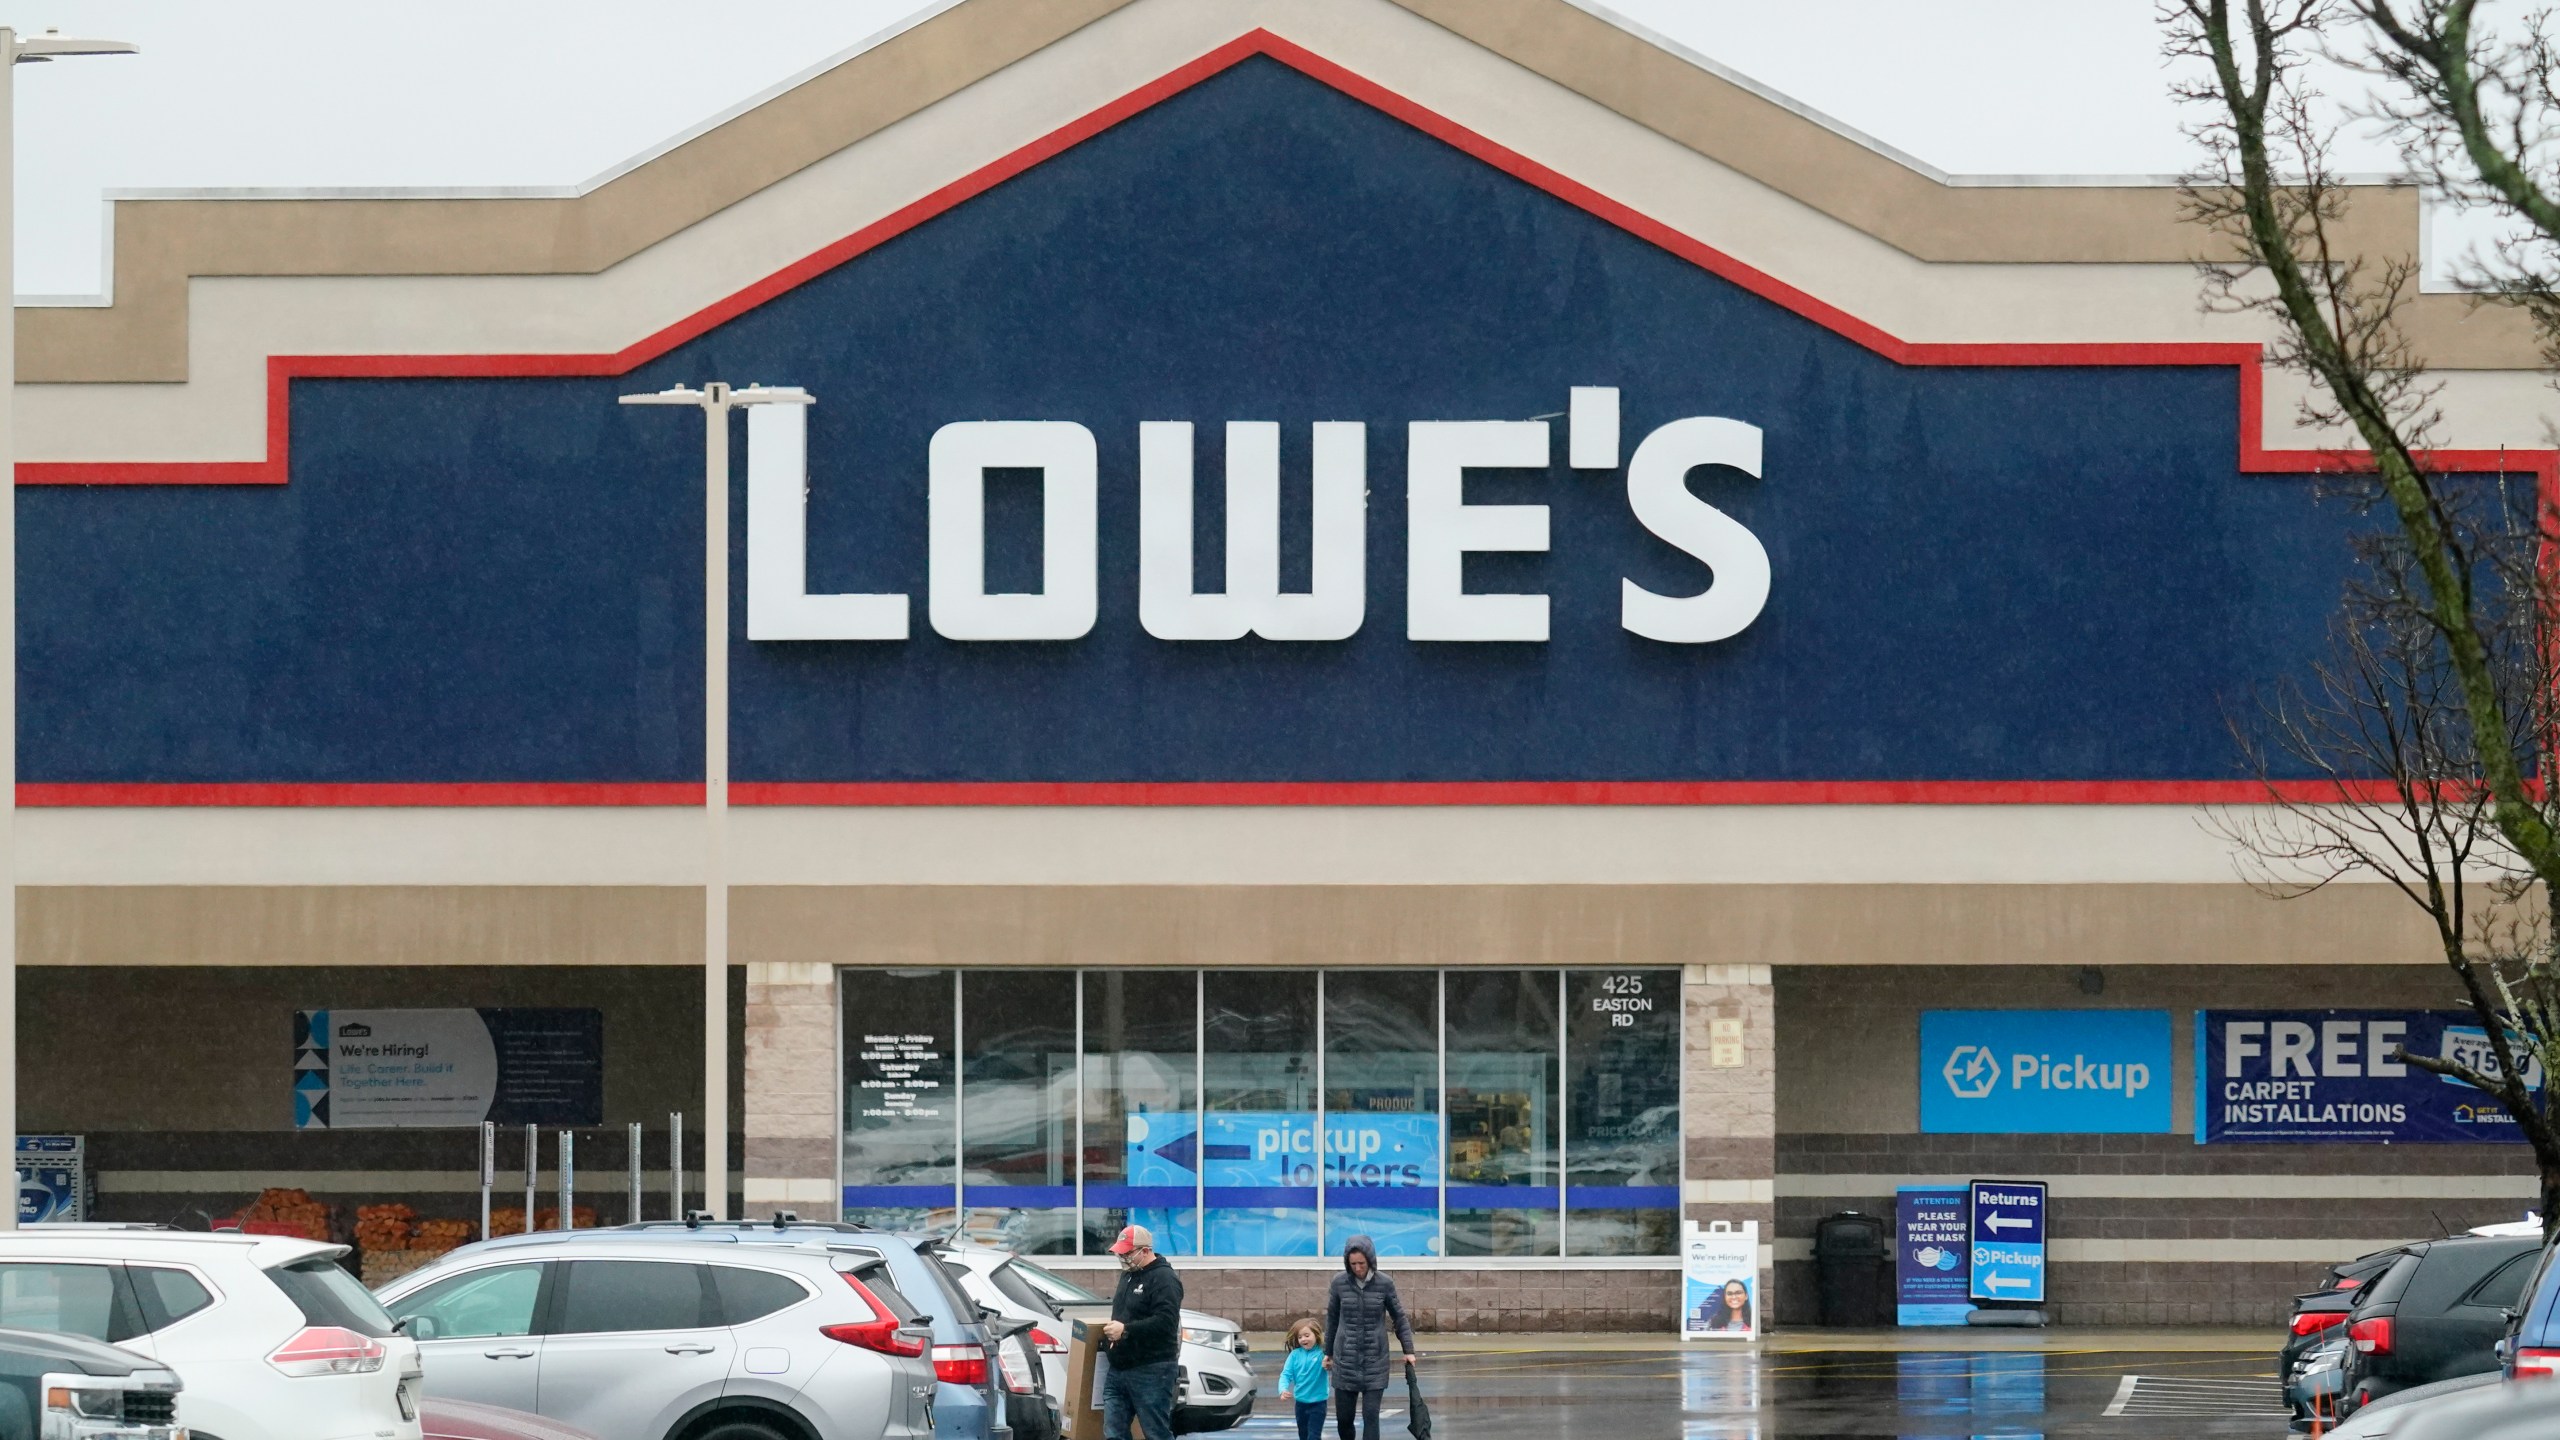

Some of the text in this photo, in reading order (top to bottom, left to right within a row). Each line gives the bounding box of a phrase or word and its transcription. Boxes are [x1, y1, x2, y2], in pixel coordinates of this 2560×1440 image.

[747, 386, 1771, 643] LOWE'S
[1602, 976, 1643, 994] 425
[1592, 998, 1652, 1011] EASTON
[1612, 1014, 1634, 1027] RD
[864, 1034, 899, 1044] Monday
[905, 1034, 934, 1044] Friday
[1714, 1035, 1740, 1044] PARKING
[2452, 1036, 2491, 1049] Averag
[339, 1044, 429, 1058] We're Hiring!
[2225, 1021, 2407, 1078] FREE
[2453, 1045, 2530, 1075] $150
[368, 1064, 410, 1074] Career.
[414, 1063, 442, 1073] Build
[880, 1063, 920, 1072] Saturday
[2012, 1054, 2150, 1098] Pickup
[340, 1077, 391, 1089] Together
[884, 1092, 917, 1101] Sunday
[2225, 1081, 2315, 1101] CARPET
[1369, 1097, 1415, 1110] PRODUC
[2225, 1104, 2407, 1123] INSTALLATIONS
[2477, 1114, 2518, 1123] INSTALL
[1258, 1120, 1381, 1161] pickup
[1281, 1155, 1422, 1188] lockers
[20, 1197, 31, 1205] ue
[1913, 1197, 1960, 1205] ATTENTION
[1979, 1191, 2038, 1207] Returns
[20, 1205, 37, 1213] ino
[1917, 1212, 1957, 1221] PLEASE
[1907, 1223, 1967, 1231] WEAR YOUR
[1908, 1233, 1966, 1242] FACE MASK
[1718, 1253, 1748, 1263] Hiring!
[1990, 1250, 2042, 1268] Pickup
